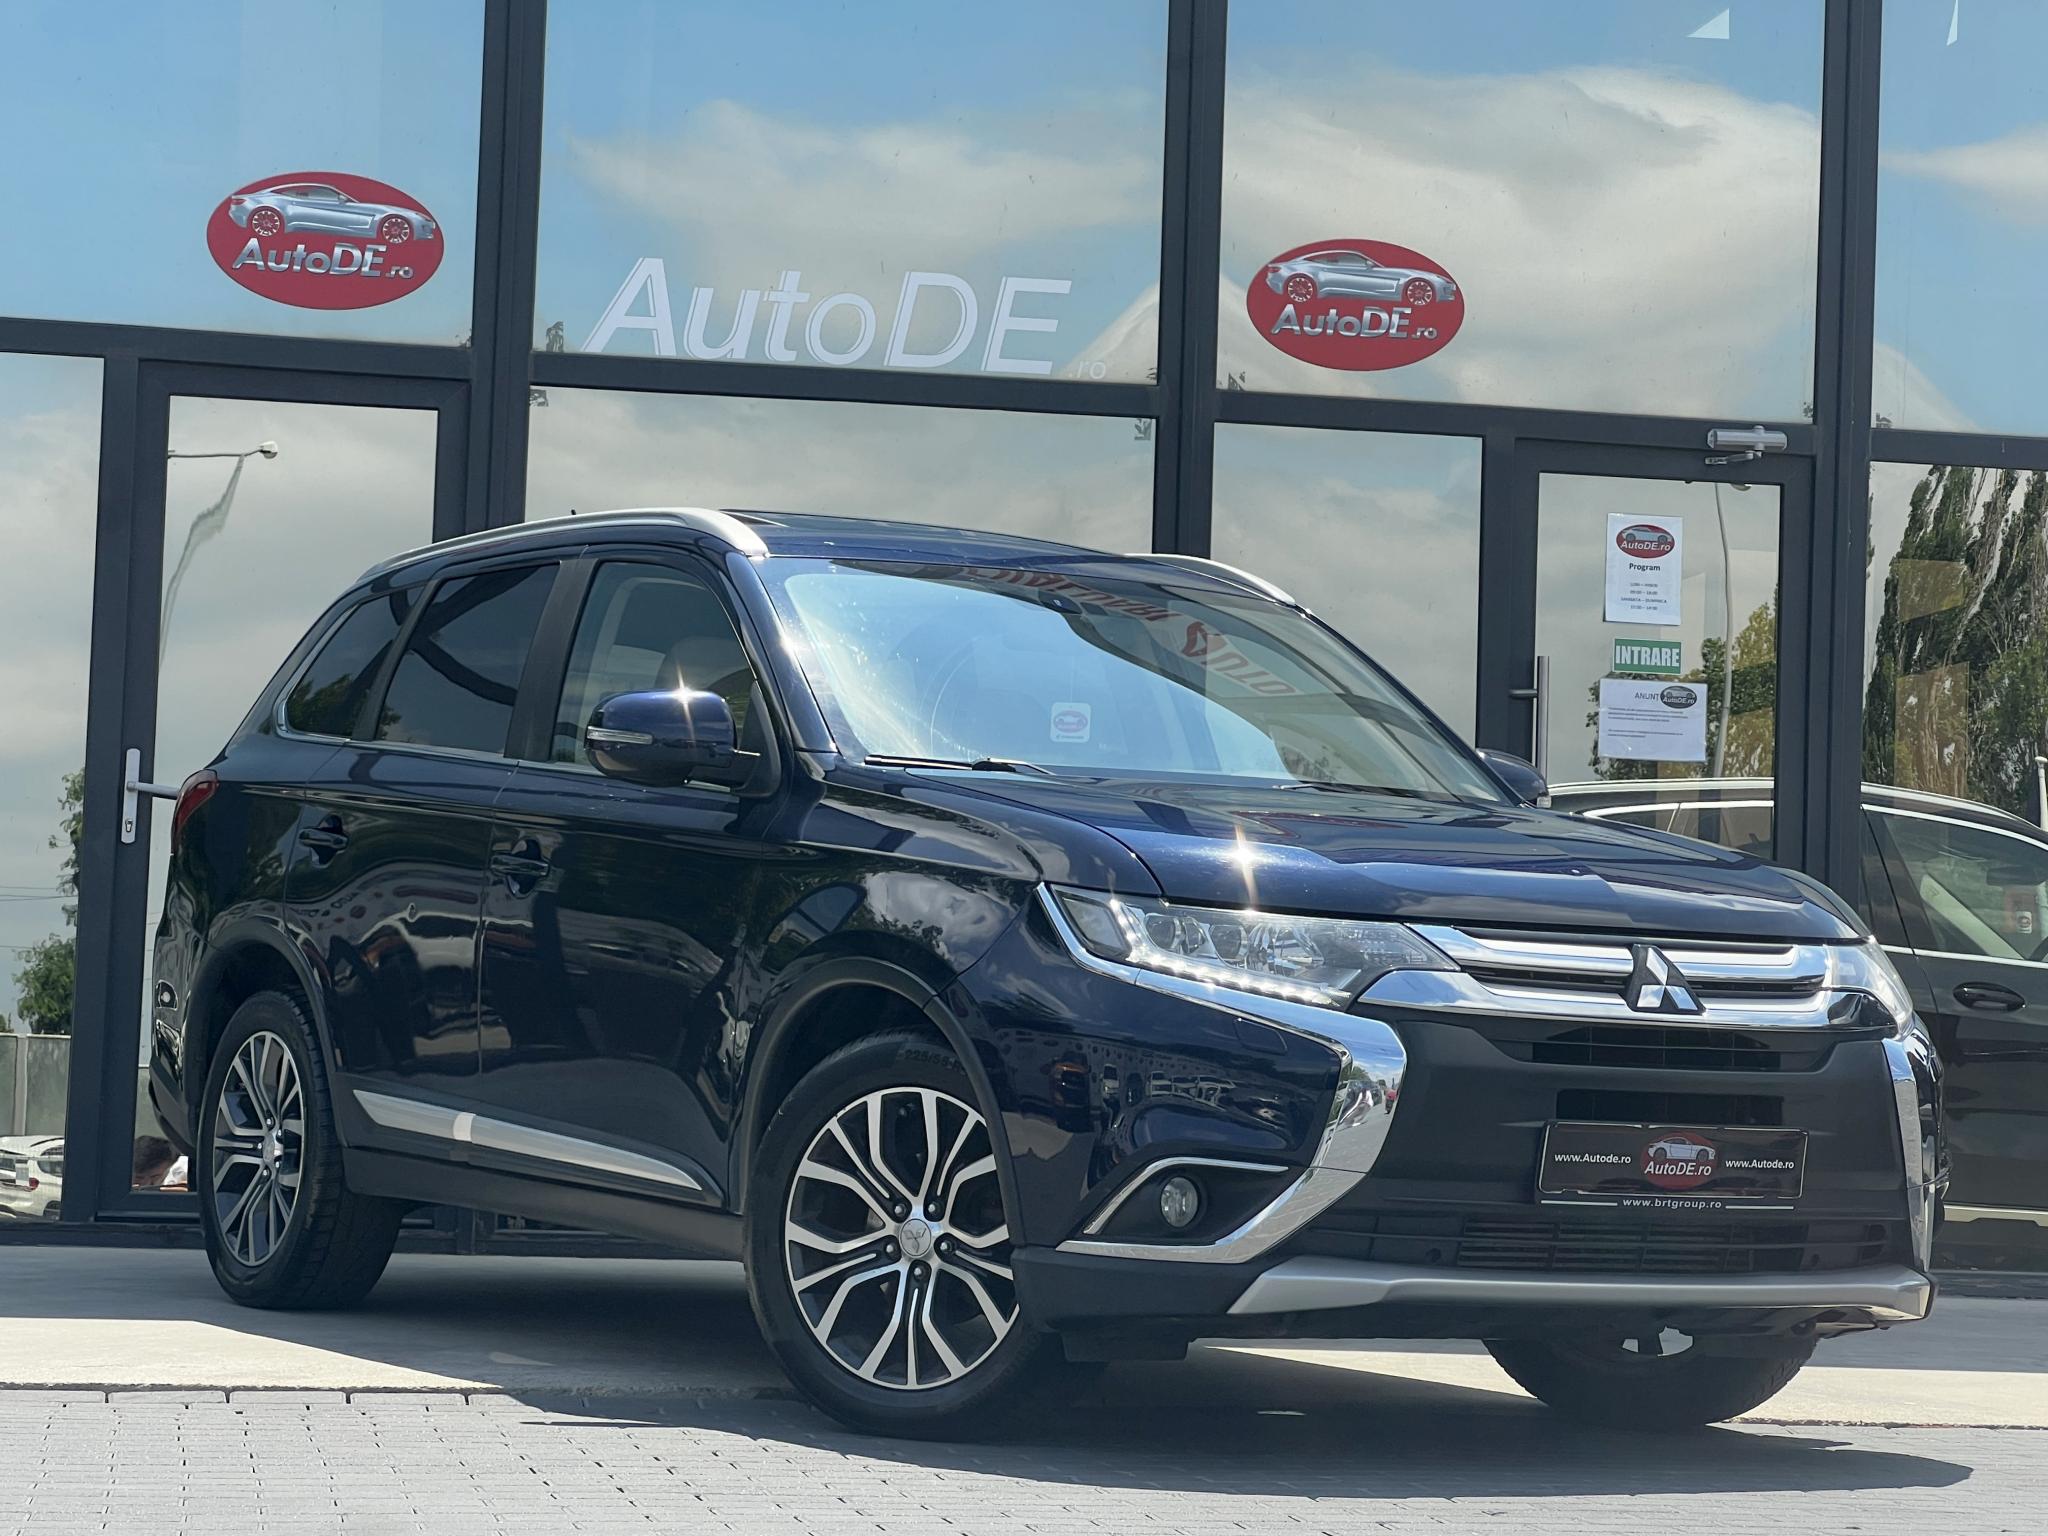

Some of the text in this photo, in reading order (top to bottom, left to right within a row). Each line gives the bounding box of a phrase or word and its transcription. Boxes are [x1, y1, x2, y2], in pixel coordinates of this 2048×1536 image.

[1620, 540, 1671, 551] AutoDE.ro
[1628, 562, 1661, 572] Program
[1615, 645, 1680, 667] INTRARE
[1554, 1153, 1632, 1165] www.Autode.ro
[1725, 1158, 1795, 1170] www.Autode.ro
[1644, 1161, 1712, 1176] AutoDE.ro
[1622, 1198, 1722, 1210] www.brtgroup.ro
